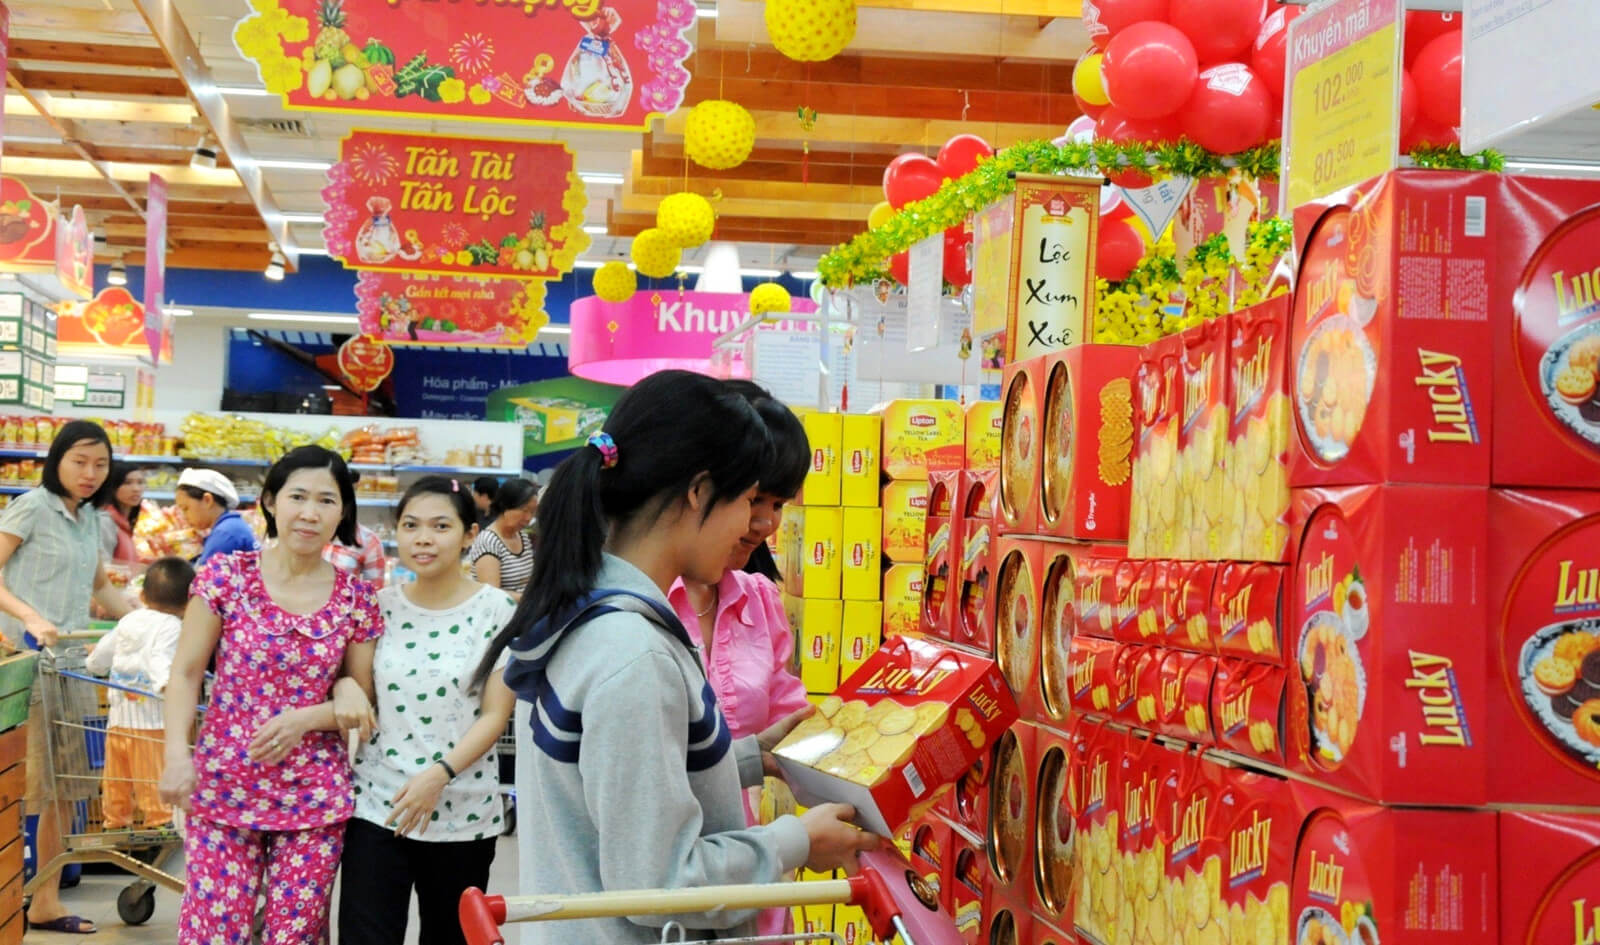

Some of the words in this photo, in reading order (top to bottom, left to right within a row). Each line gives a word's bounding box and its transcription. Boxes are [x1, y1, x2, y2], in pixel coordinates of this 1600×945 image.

[1294, 12, 1341, 64] Khuyến
[405, 146, 459, 177] Tấn
[470, 150, 515, 180] Tài
[400, 181, 454, 211] Tấn
[463, 186, 517, 221] Lộc
[1040, 237, 1071, 263] Lộc
[1025, 278, 1077, 310] Xum
[1306, 257, 1339, 323] Lucky
[1028, 320, 1073, 347] Xuê
[423, 376, 450, 389] Hóa
[452, 375, 489, 391] phẩm
[1415, 347, 1473, 444] Lucky
[912, 415, 936, 426] Lipton
[1305, 550, 1335, 606] Lucky
[969, 684, 1002, 722] Lucky
[1404, 649, 1466, 747] Lucky
[1230, 809, 1272, 878] Lucky
[1309, 850, 1344, 906] Lucky
